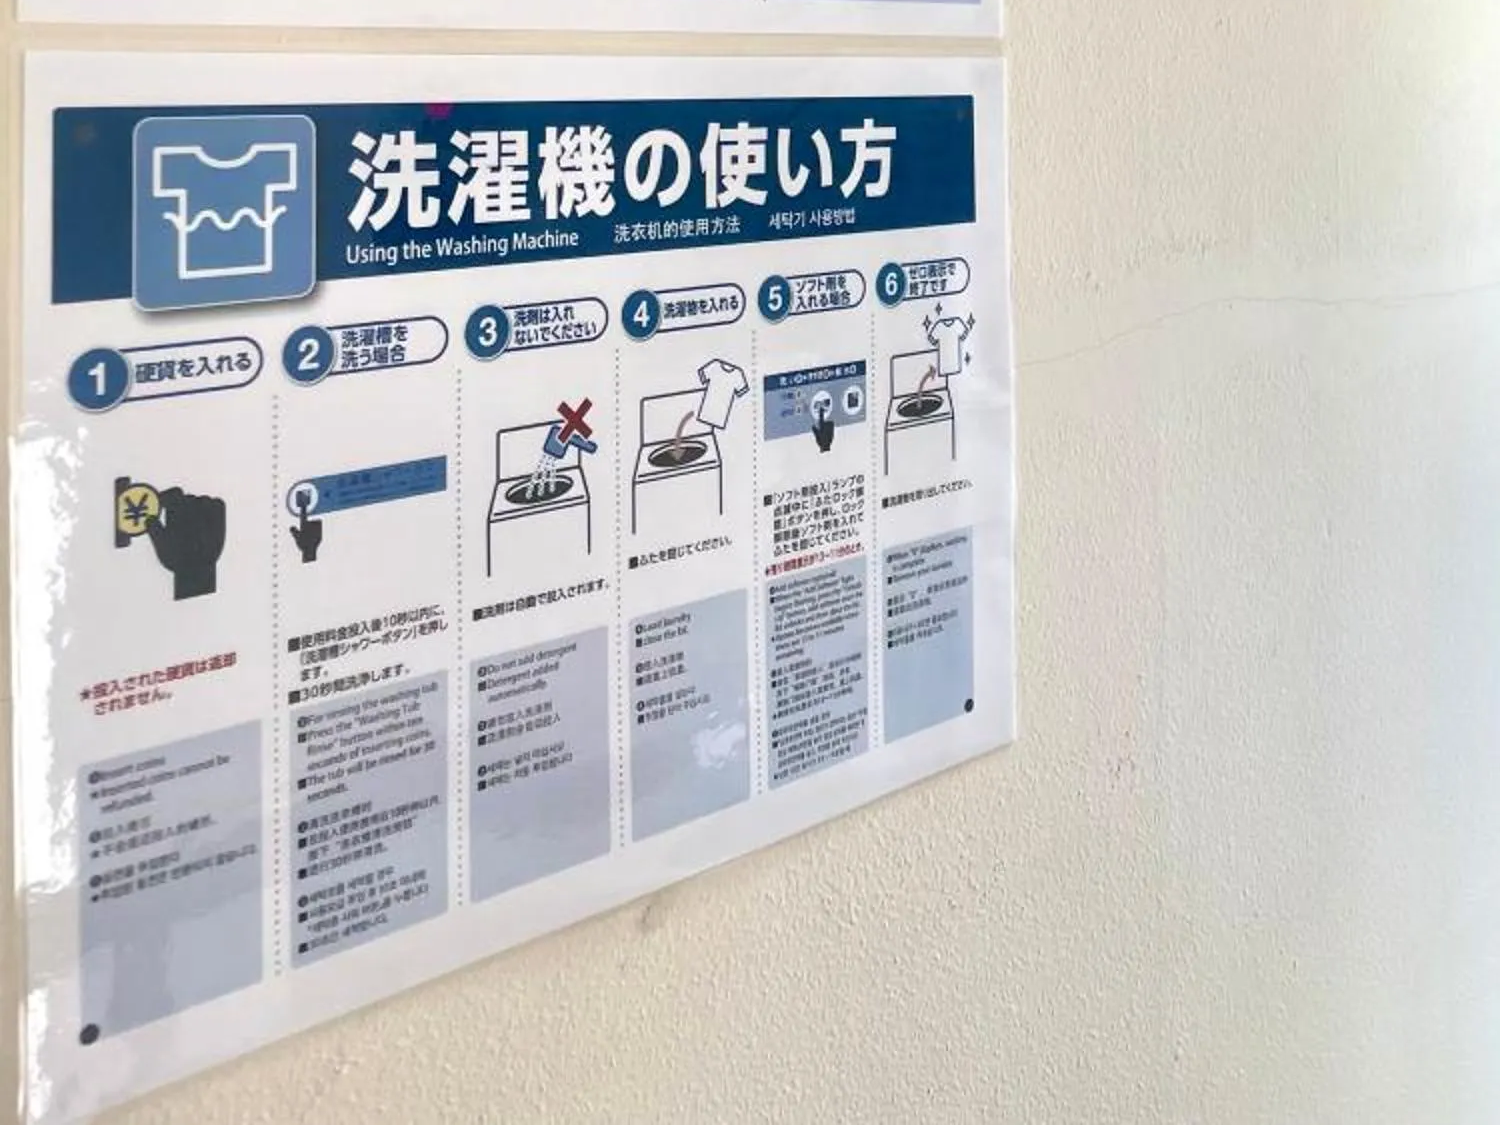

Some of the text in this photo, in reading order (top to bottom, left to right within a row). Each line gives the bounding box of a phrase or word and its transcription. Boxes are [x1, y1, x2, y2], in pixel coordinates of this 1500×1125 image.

[346, 117, 898, 233] 洗濯機の使い方
[614, 215, 741, 243] 洗衣机的使用方法
[345, 230, 580, 265] Using the Washing Machine
[795, 275, 847, 294] ソフト剤を
[884, 273, 898, 296] 6
[663, 294, 739, 319] 洗濯物を入れる
[767, 285, 783, 311] 5
[796, 289, 851, 308] 入れる場合
[513, 305, 575, 328] 洗剤は入れ
[632, 299, 650, 328] 4
[341, 325, 409, 348] 洗濯槽を
[478, 316, 499, 347] 3
[514, 322, 598, 345] ないでください
[135, 351, 252, 384] 硬貨を入れる
[298, 338, 320, 371] 2
[341, 346, 406, 369] 洗う場合
[88, 361, 106, 396] 1
